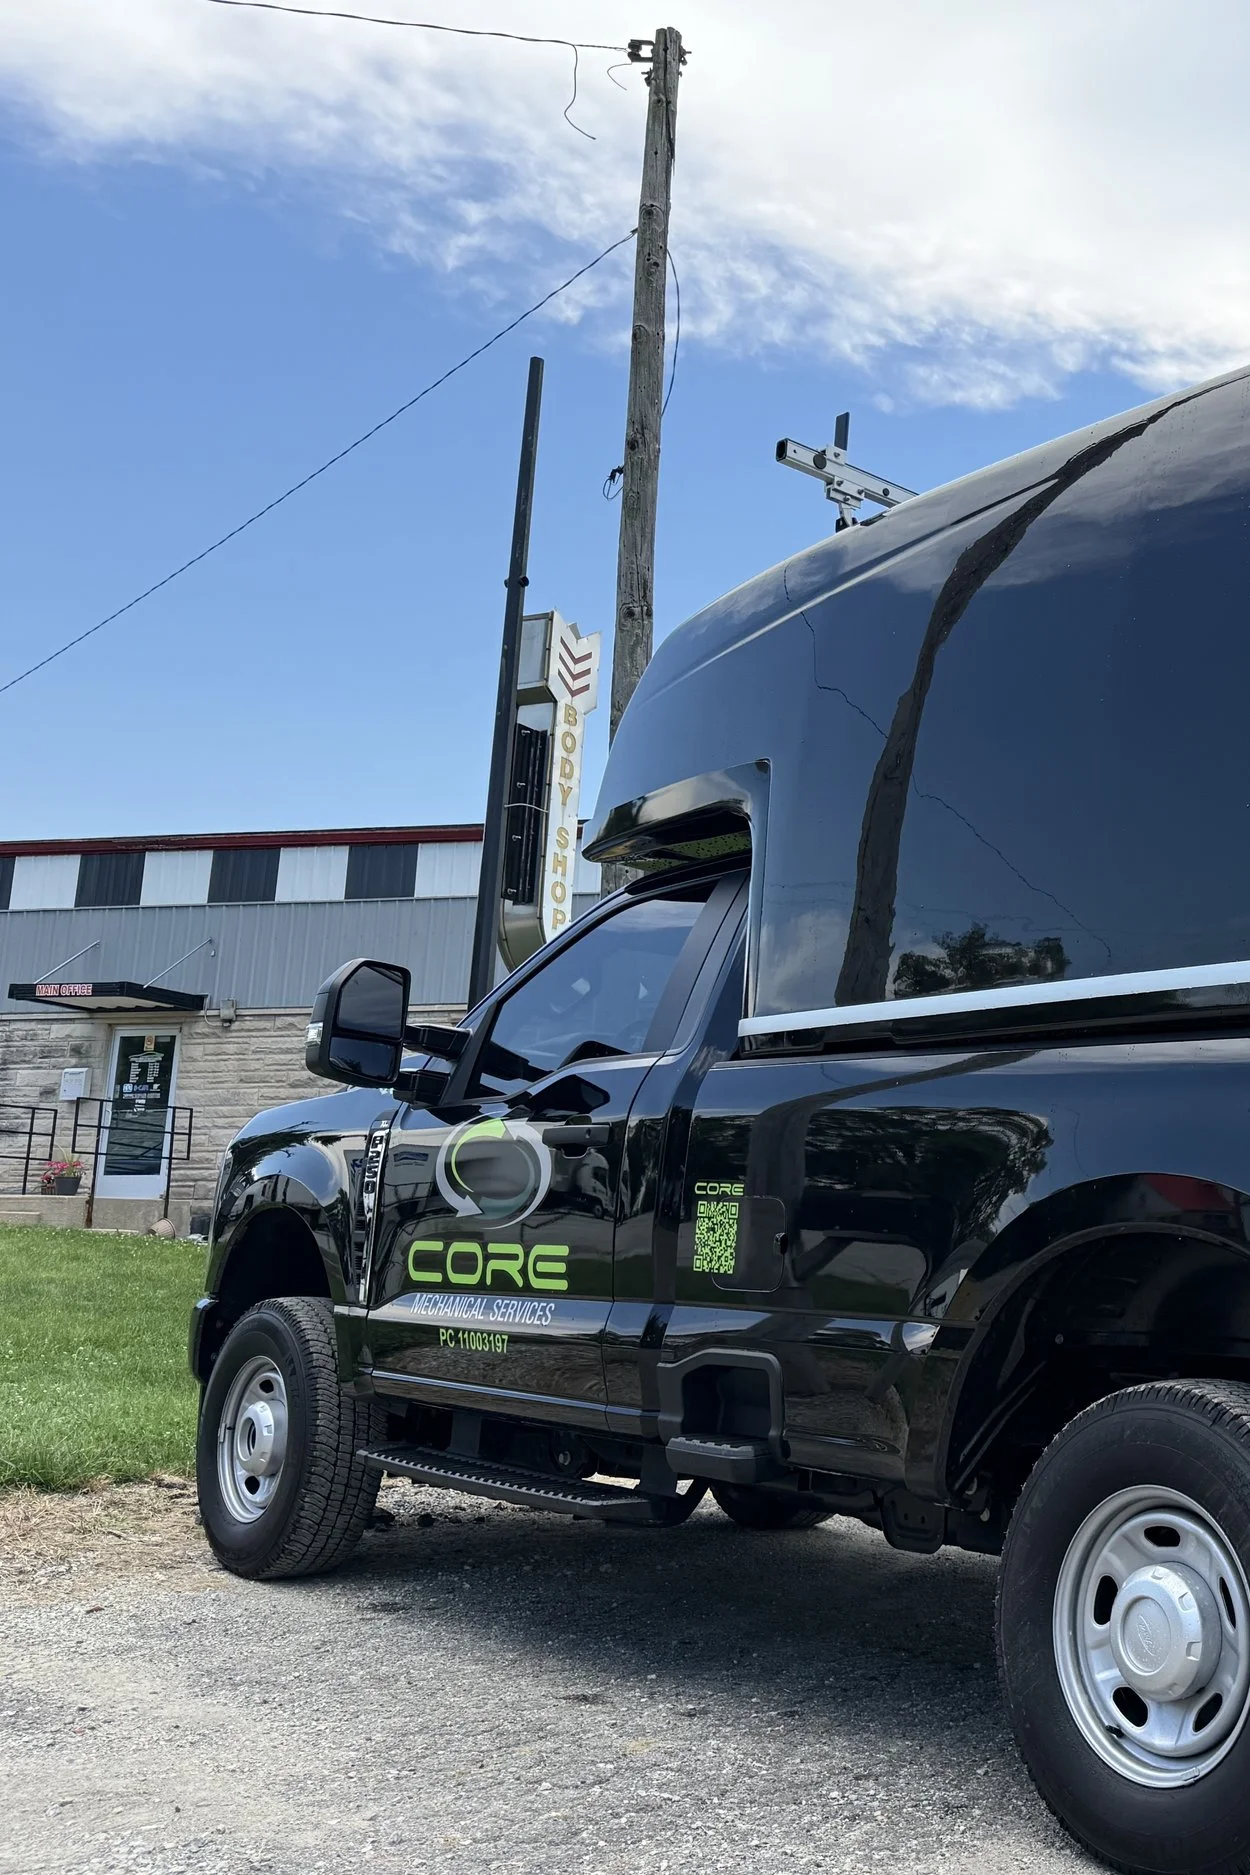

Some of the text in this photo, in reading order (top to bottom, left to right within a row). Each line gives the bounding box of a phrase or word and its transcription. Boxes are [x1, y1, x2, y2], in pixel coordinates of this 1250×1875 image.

[551, 703, 578, 930] BODY SHOP
[35, 983, 93, 996] MAIN OFFICE
[694, 1182, 745, 1196] CORE
[407, 1240, 570, 1291] CORE
[410, 1293, 556, 1326] MECHANICAL SERVICES
[439, 1328, 509, 1354] PC 11003197
